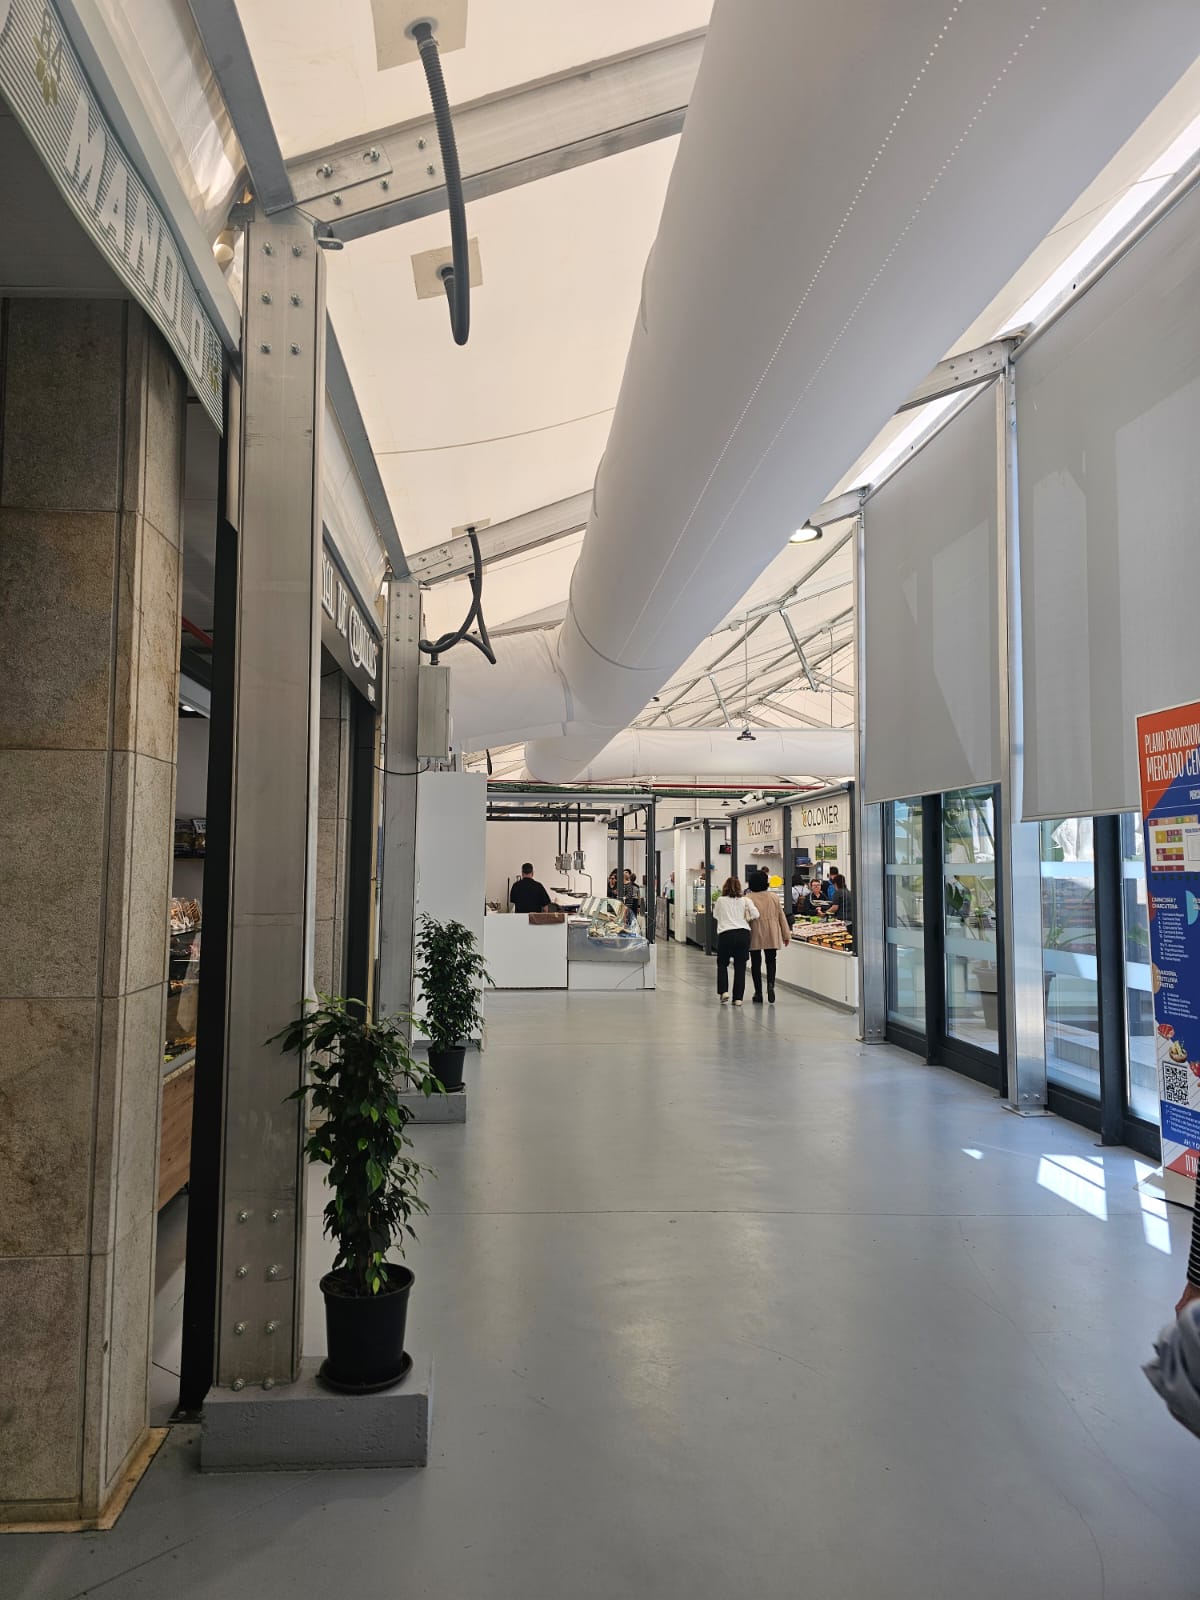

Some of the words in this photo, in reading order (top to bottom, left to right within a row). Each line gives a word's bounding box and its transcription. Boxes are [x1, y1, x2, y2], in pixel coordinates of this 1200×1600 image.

[64, 90, 207, 382] MANOLO
[1144, 731, 1165, 754] PLANO
[1146, 751, 1184, 783] MERCADO
[801, 805, 839, 827] COLOMER
